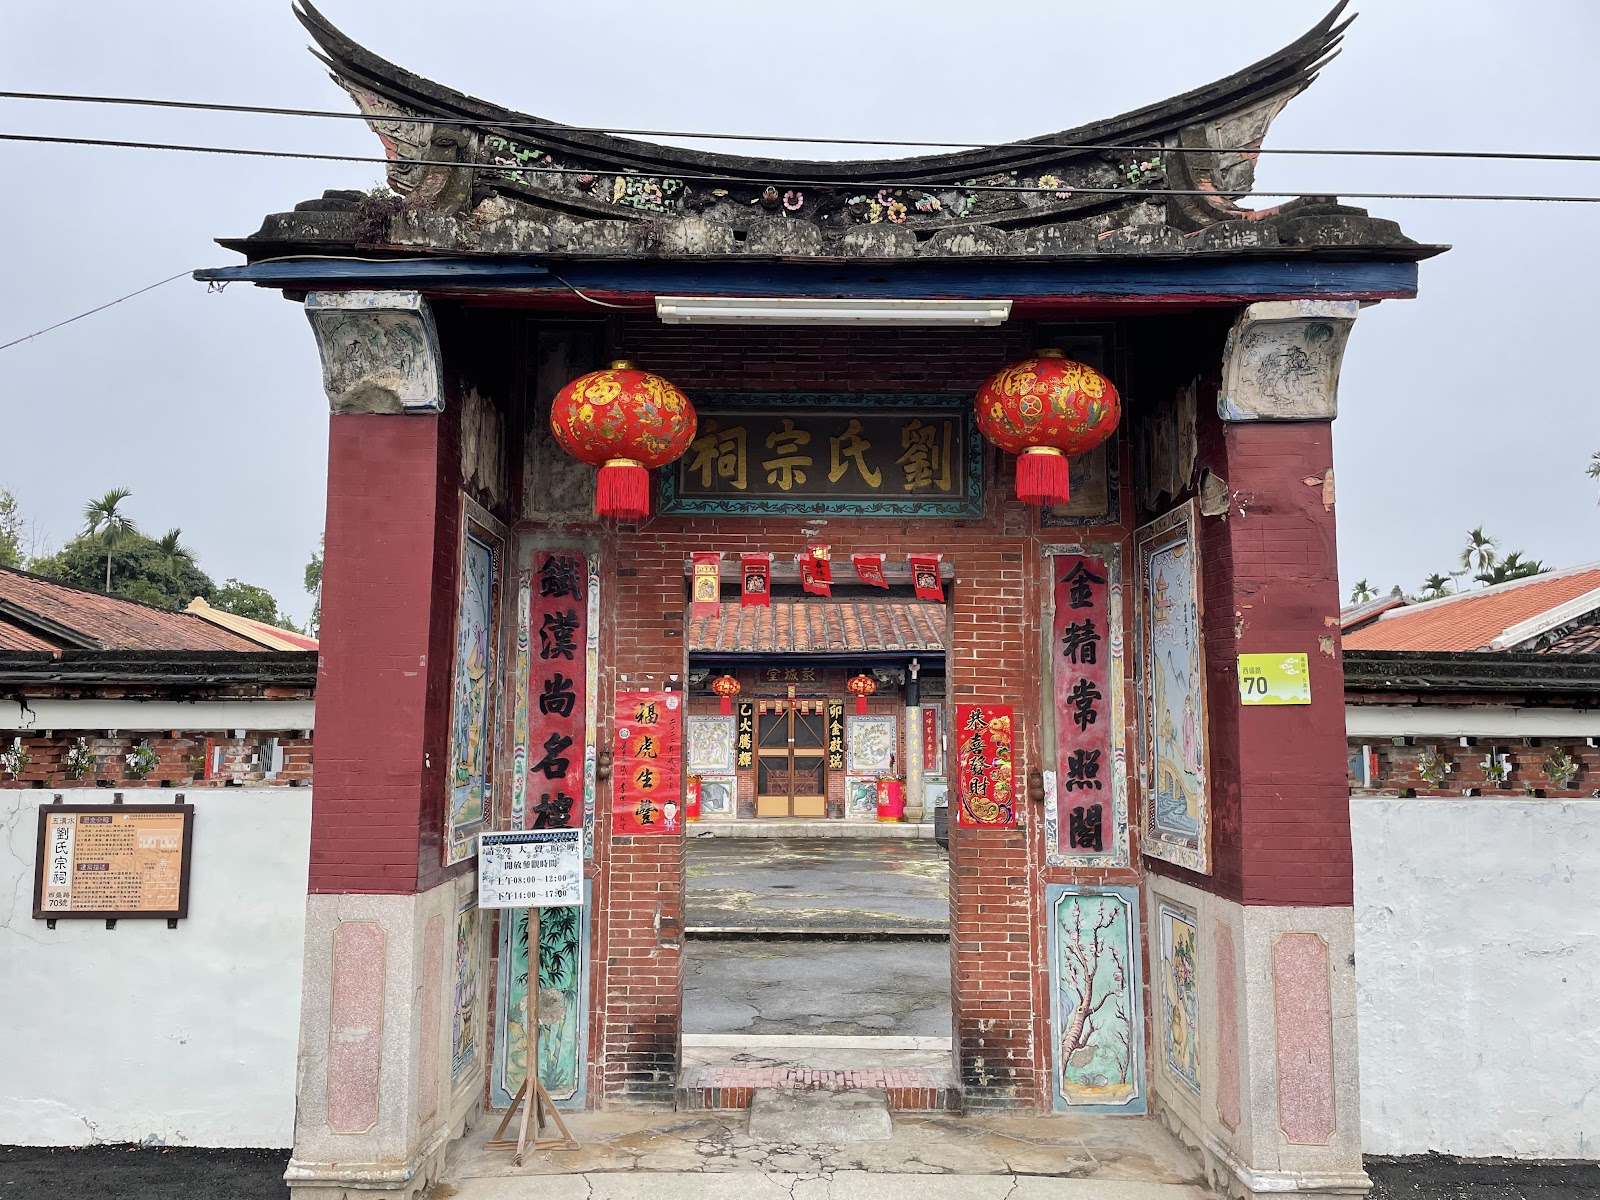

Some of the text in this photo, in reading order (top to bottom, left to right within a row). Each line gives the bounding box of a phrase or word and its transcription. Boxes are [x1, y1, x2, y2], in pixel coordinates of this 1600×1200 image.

[1243, 677, 1267, 694] 70
[964, 708, 992, 796] 恭喜發財
[52, 827, 70, 885] 劉氏宗祠
